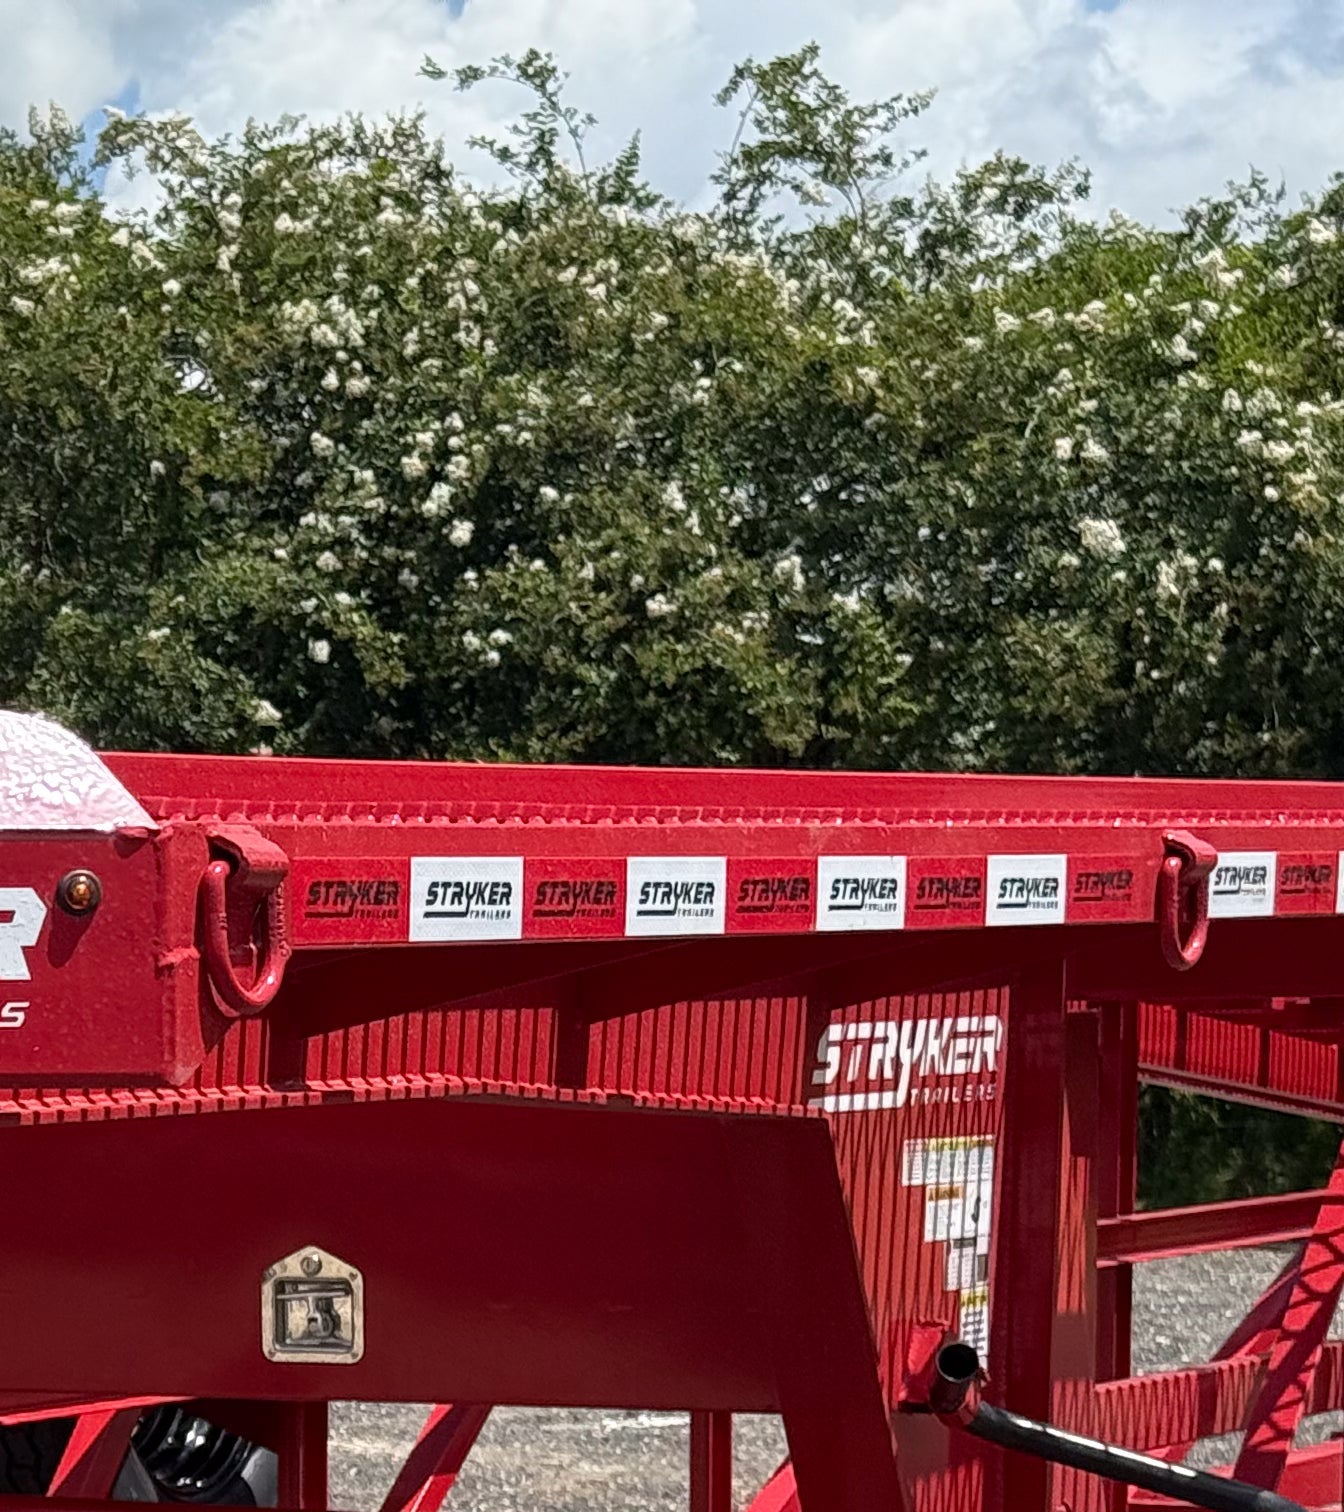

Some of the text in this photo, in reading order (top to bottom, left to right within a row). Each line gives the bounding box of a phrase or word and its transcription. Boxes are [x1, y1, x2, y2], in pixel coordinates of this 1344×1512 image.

[636, 881, 716, 916] STRYKER
[735, 877, 811, 914] STRYKER
[828, 878, 898, 912] STRYKER
[913, 877, 982, 910] STRYKER
[997, 877, 1060, 909] STRYKER
[1213, 866, 1267, 896] STRYKER
[304, 880, 401, 918] STRYKER
[423, 881, 513, 919] STRYKER
[532, 881, 618, 917] STRYKER
[807, 1014, 1004, 1114] STRYKER
[910, 1083, 998, 1107] TRAILERS
